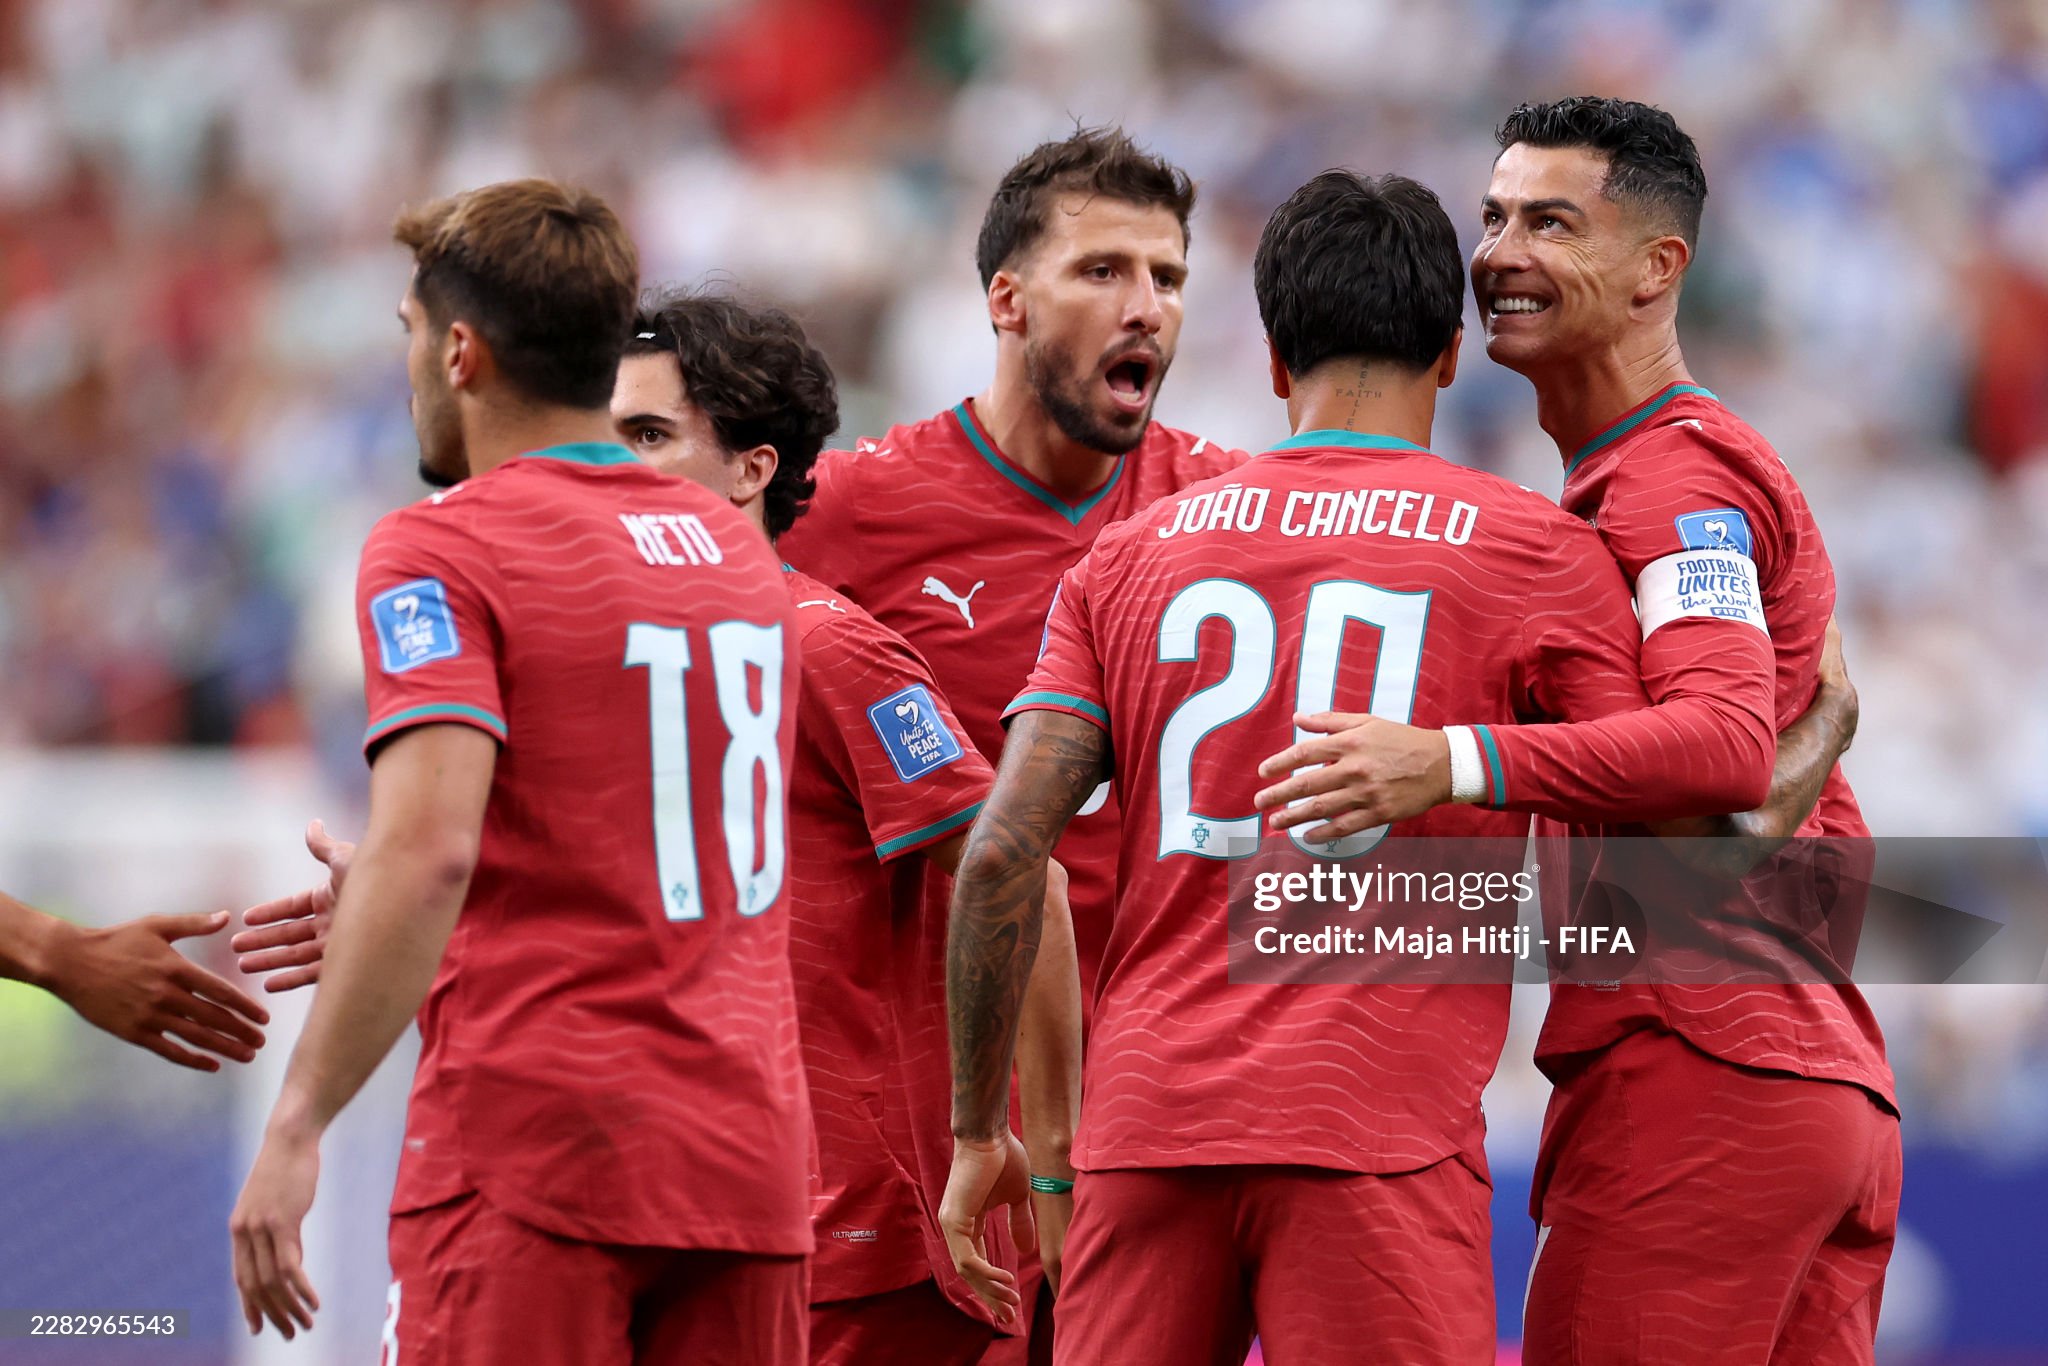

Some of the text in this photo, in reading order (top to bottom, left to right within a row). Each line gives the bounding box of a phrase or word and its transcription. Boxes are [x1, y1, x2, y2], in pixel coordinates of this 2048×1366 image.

[1335, 388, 1382, 398] FAITH
[1157, 483, 1479, 546] JOÃO CANCELO
[617, 513, 723, 566] NETO
[1676, 558, 1750, 579] FOOTBALL
[1677, 574, 1752, 597] UNITES
[1677, 596, 1712, 611] the
[1711, 606, 1747, 618] FIFA
[1157, 577, 1433, 862] 20
[900, 719, 935, 746] Unite To
[907, 732, 943, 759] PEACE
[921, 750, 942, 765] FIFA
[623, 620, 786, 922] 18
